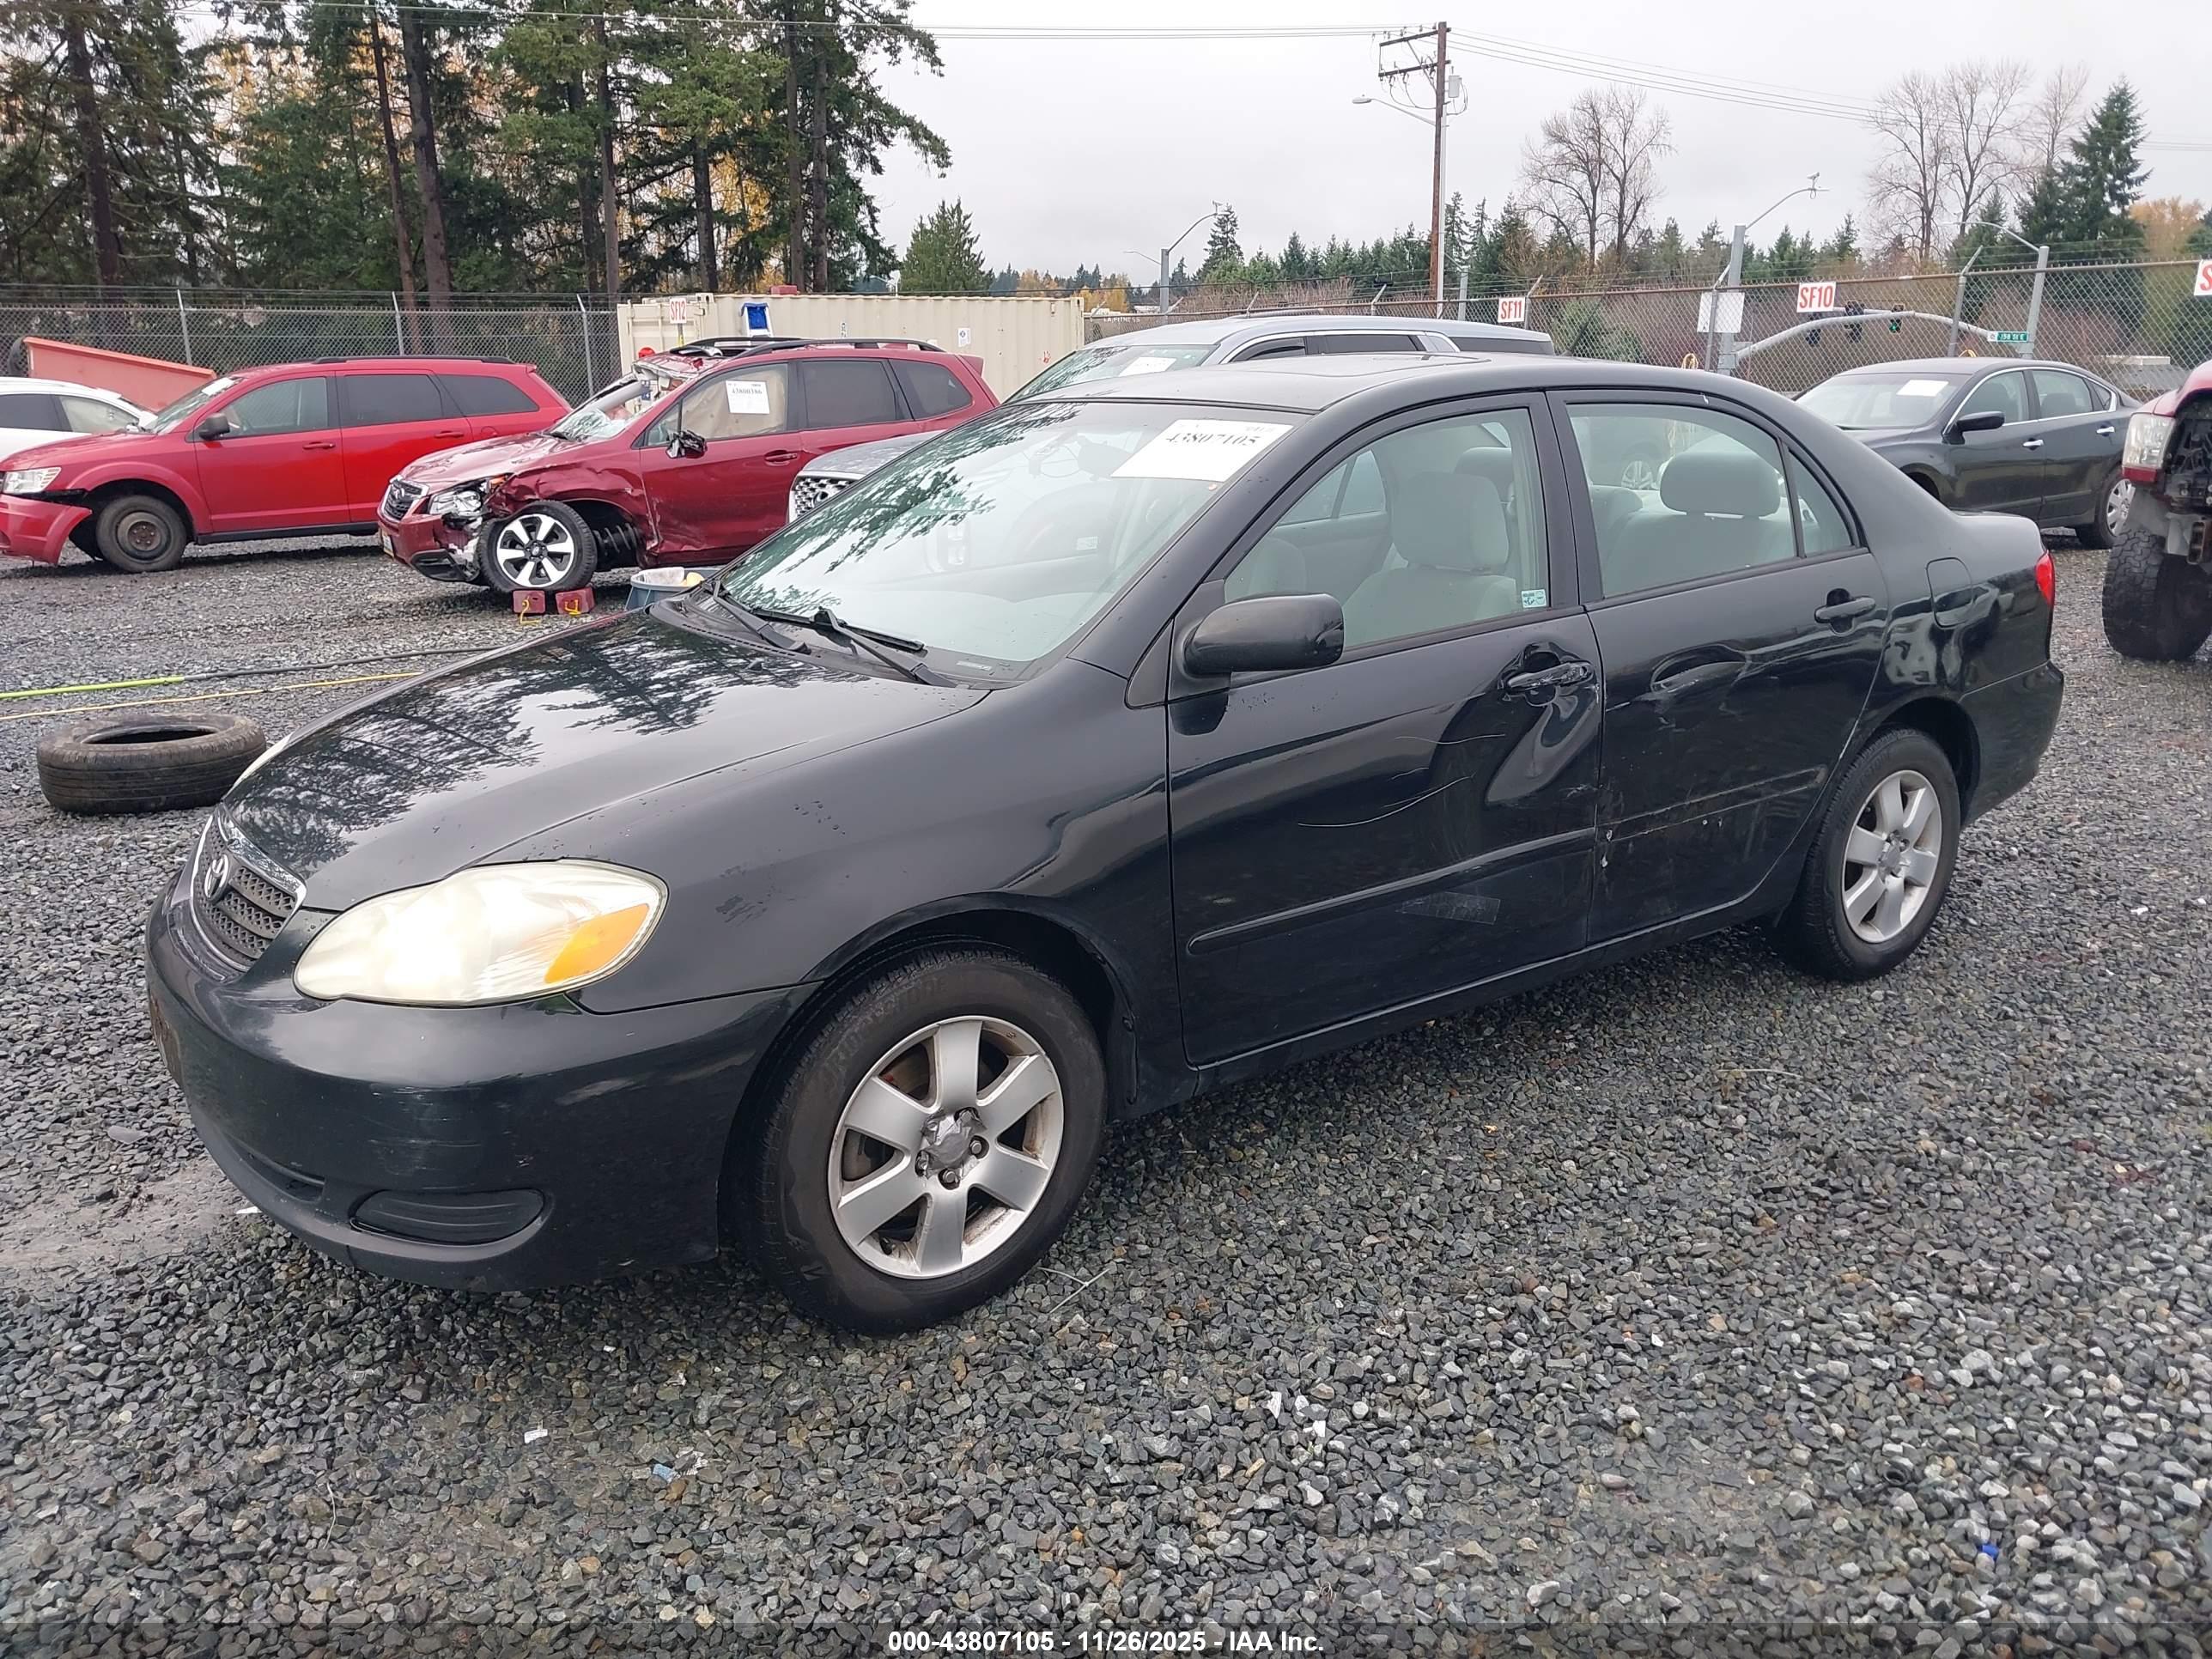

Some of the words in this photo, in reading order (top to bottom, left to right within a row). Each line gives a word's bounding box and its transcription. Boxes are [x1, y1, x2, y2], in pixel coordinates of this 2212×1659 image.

[1799, 285, 1833, 308] SF10
[671, 301, 686, 320] SF12
[1500, 301, 1522, 319] SF11
